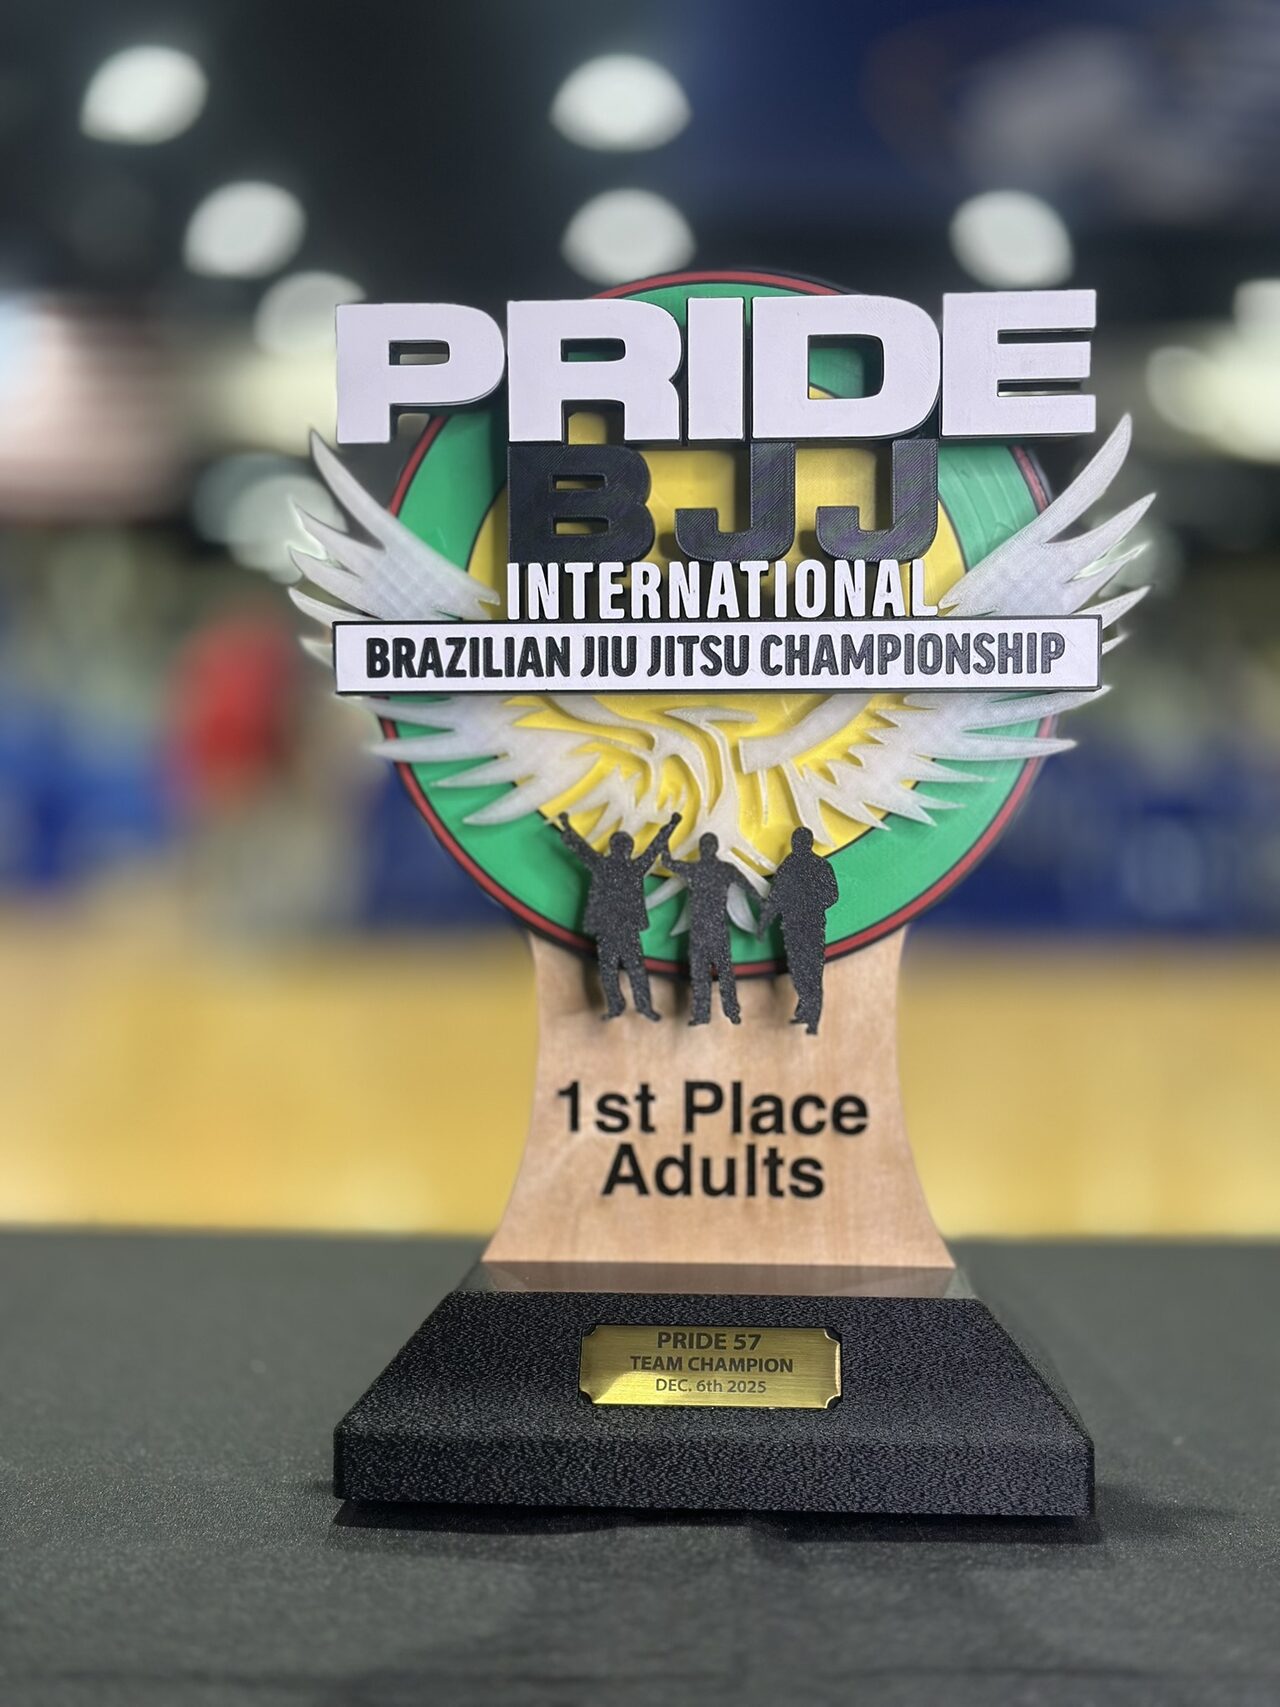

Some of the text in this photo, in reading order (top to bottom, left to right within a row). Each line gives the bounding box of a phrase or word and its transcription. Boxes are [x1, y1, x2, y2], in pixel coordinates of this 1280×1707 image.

[336, 289, 1096, 444] PRIDE
[507, 441, 939, 563] BJJ
[506, 558, 939, 621] INTERNATIONAL
[366, 632, 1066, 679] BRAZILIAN JIU JITSU CHAMPIONSHIP
[557, 1080, 869, 1136] 1st Place
[602, 1143, 825, 1199] Adults
[630, 1355, 793, 1373] TEAM CHAMPION
[656, 1331, 762, 1351] PRIDE 57
[655, 1378, 767, 1394] DEC. 6th 2025
